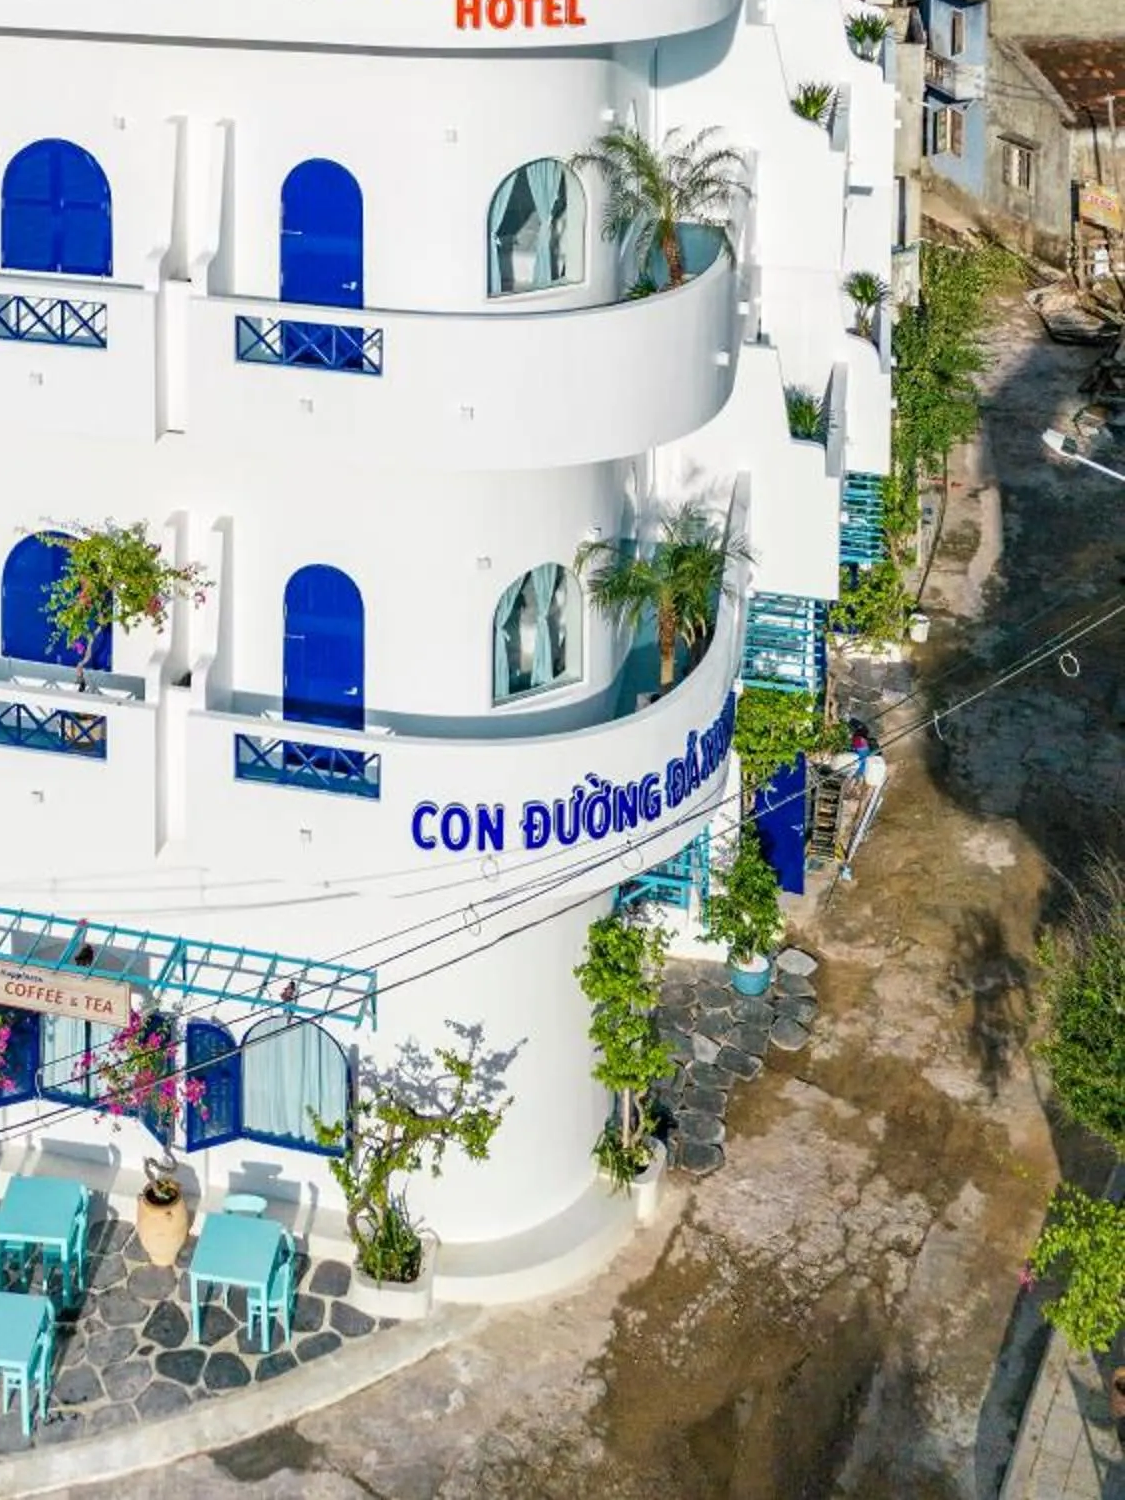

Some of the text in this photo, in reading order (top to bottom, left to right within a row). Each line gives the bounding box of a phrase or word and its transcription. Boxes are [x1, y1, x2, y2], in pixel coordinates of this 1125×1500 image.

[411, 800, 505, 852] CON
[519, 772, 661, 851] ĐƯỜNG
[4, 981, 64, 1005] COFFEE
[84, 995, 114, 1014] TEA
